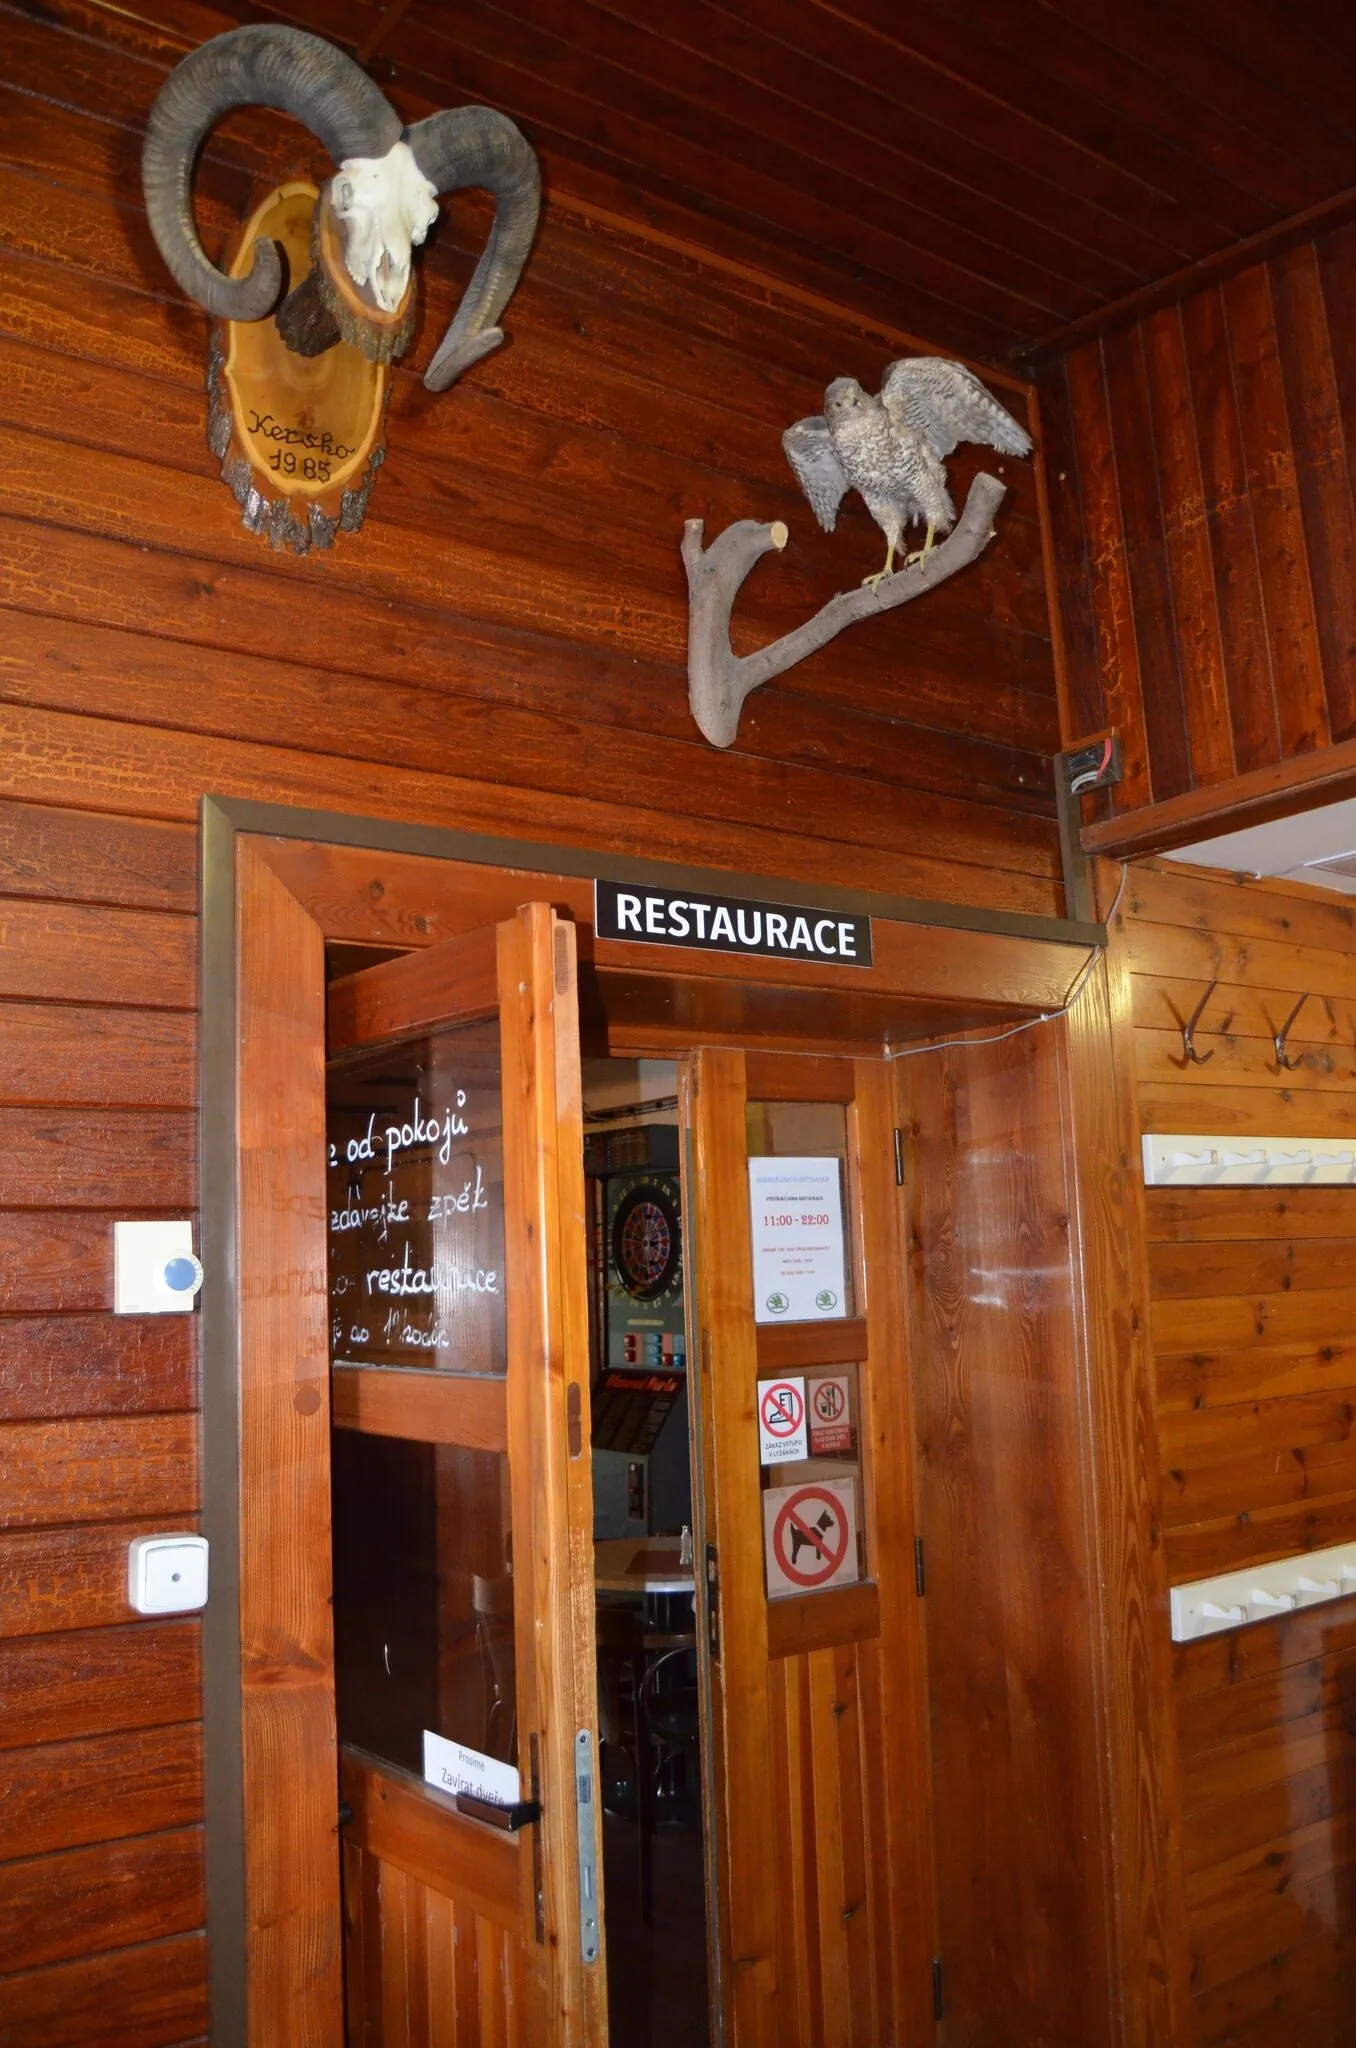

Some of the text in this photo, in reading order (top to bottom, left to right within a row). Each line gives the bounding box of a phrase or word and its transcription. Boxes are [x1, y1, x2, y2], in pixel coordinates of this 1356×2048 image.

[269, 449, 332, 483] 1985
[616, 893, 857, 957] RESTAURACE
[347, 1089, 468, 1175] od pokojů
[763, 1215, 793, 1227] 11:00
[801, 1214, 830, 1225] 22:00
[441, 1767, 473, 1795] Zavírat
